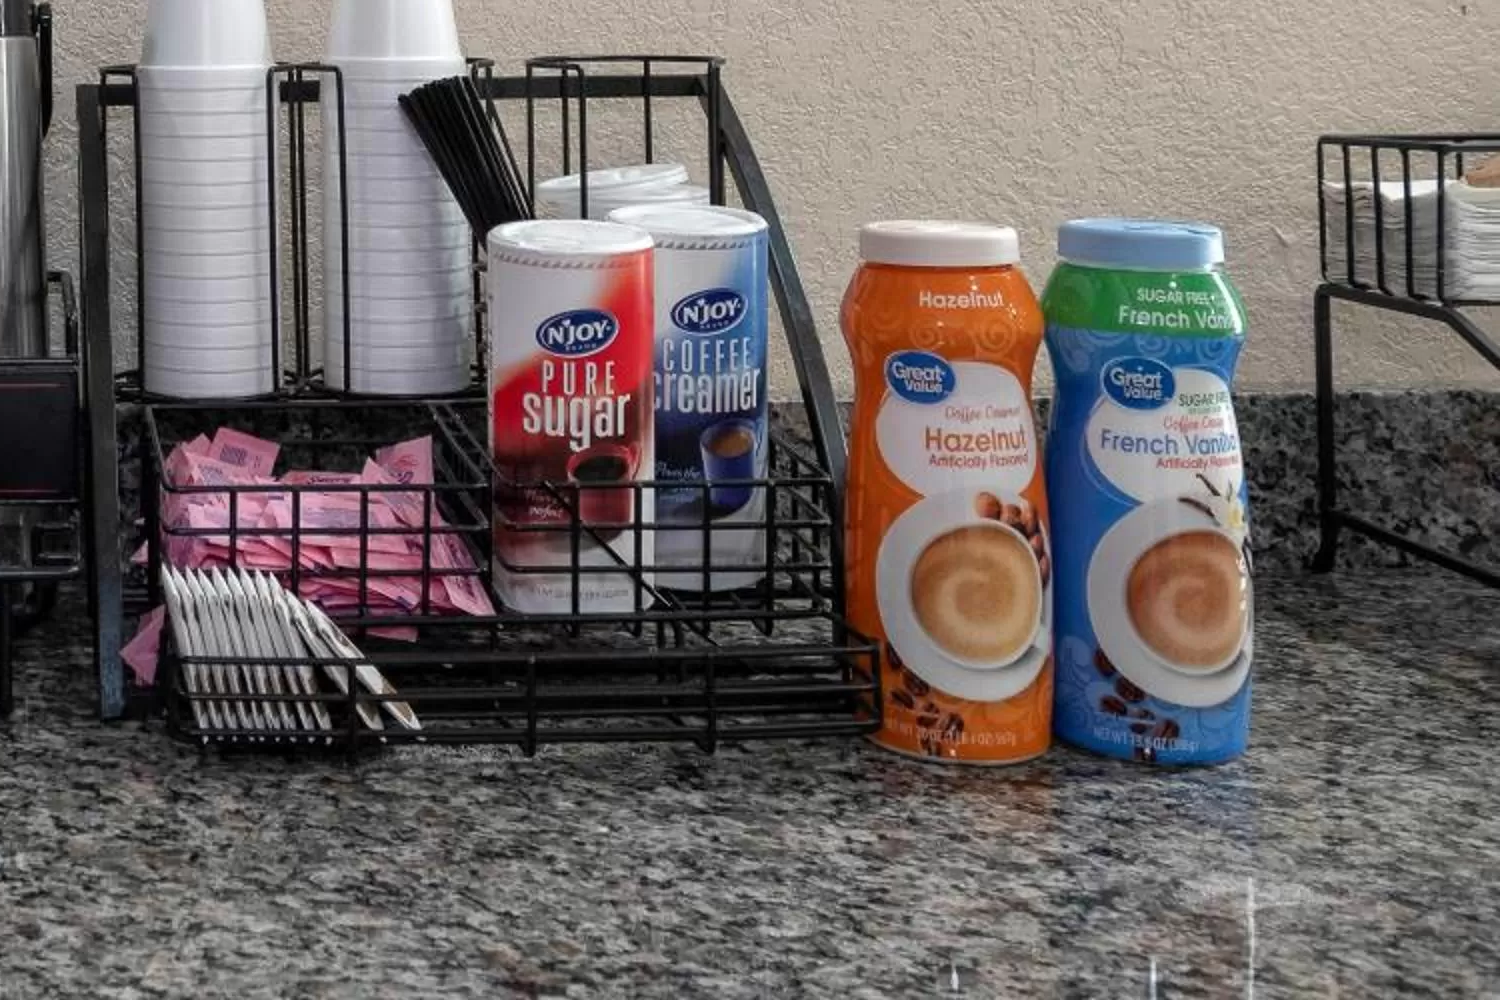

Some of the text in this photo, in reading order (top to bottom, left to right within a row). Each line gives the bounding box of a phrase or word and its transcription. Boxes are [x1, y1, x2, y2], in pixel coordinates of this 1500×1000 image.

[919, 290, 1004, 309] Hazelnut
[1137, 287, 1184, 305] SUGAR
[1119, 305, 1190, 328] French
[662, 337, 751, 373] COFFEE
[542, 359, 616, 396] PURE
[892, 361, 943, 382] Great
[1110, 367, 1162, 388] Great
[904, 379, 943, 393] Value
[1124, 385, 1162, 400] Value
[522, 391, 632, 452] sugar
[925, 424, 1027, 452] Hazelnut
[1101, 427, 1179, 455] French
